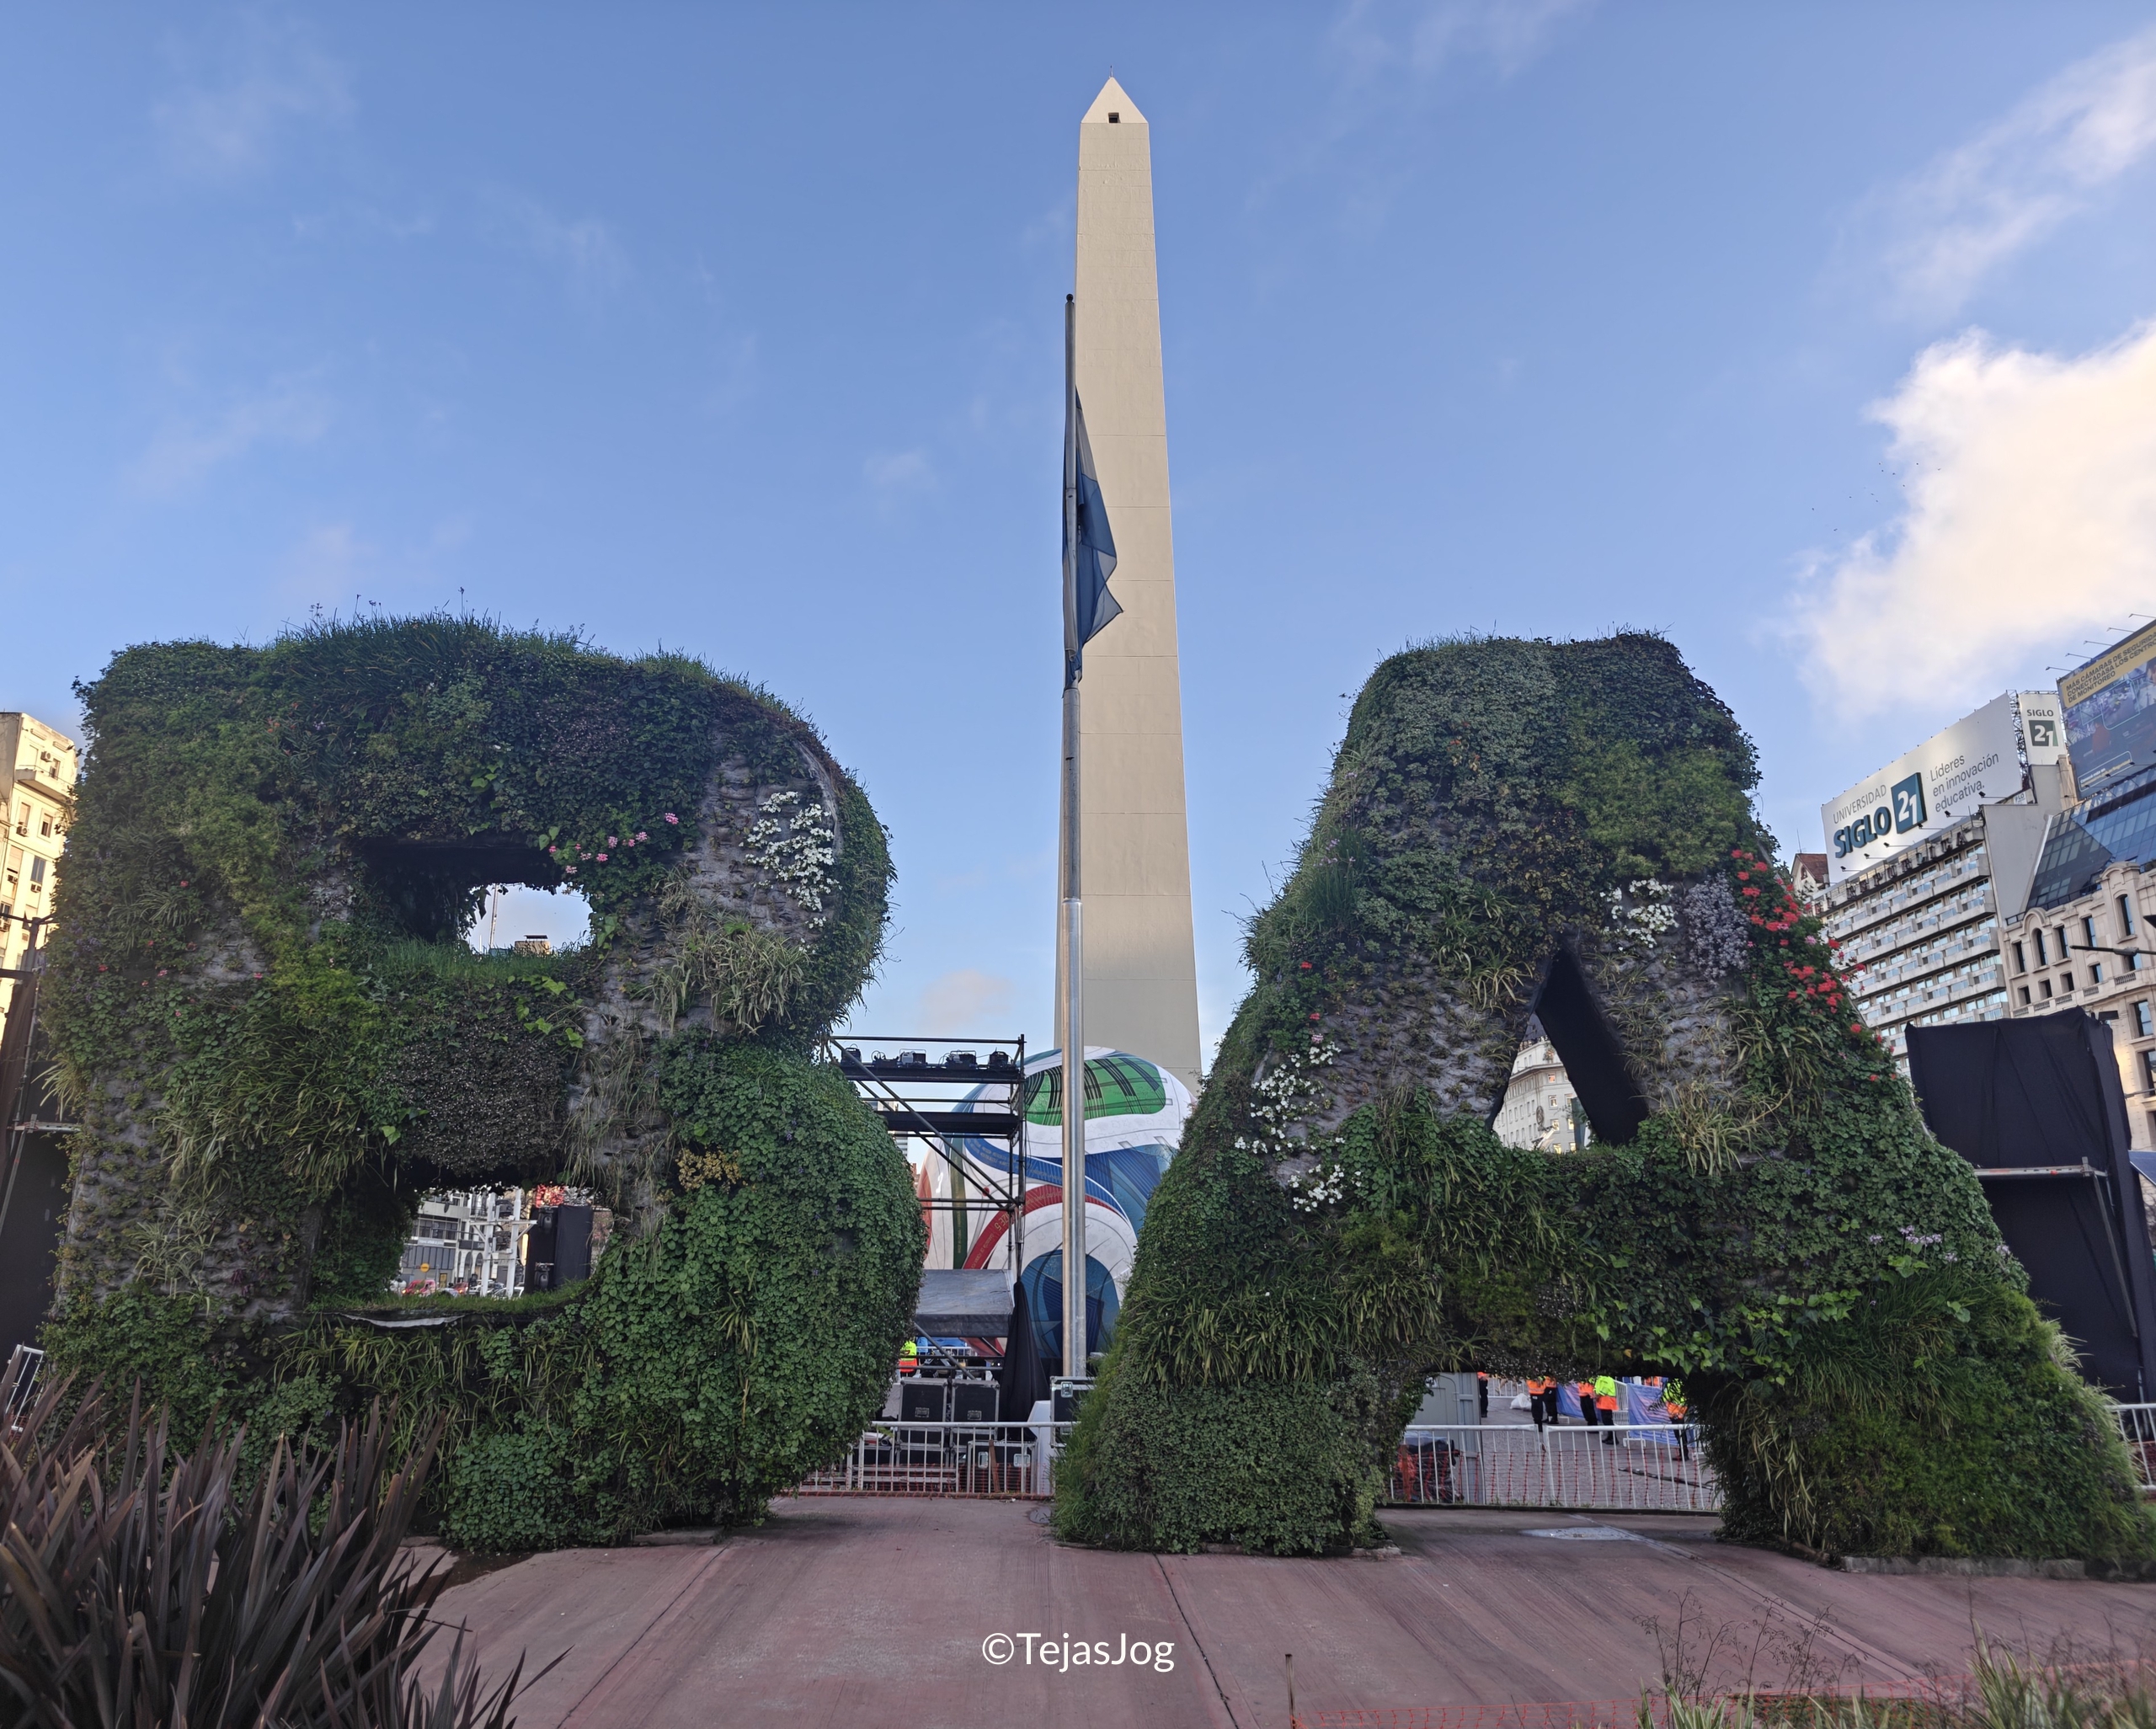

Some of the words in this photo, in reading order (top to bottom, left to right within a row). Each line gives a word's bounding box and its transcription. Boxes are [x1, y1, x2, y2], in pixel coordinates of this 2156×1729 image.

[2066, 678, 2080, 691] MÁS
[2080, 659, 2112, 682] CÁMARAS
[2112, 653, 2122, 663] DE
[2115, 656, 2129, 668] LOS
[2077, 670, 2116, 697] MONITOREO
[2026, 709, 2054, 718] SIGLO
[2034, 725, 2054, 747] 21
[1929, 755, 1966, 782] Líderes
[1933, 783, 1945, 797] en
[1945, 753, 1999, 790] innovación
[1833, 784, 1887, 824] UNIVERSIDAD
[1935, 780, 1985, 813] educativa.
[1833, 806, 1892, 858] SIGLO
[1897, 790, 1918, 825] 21
